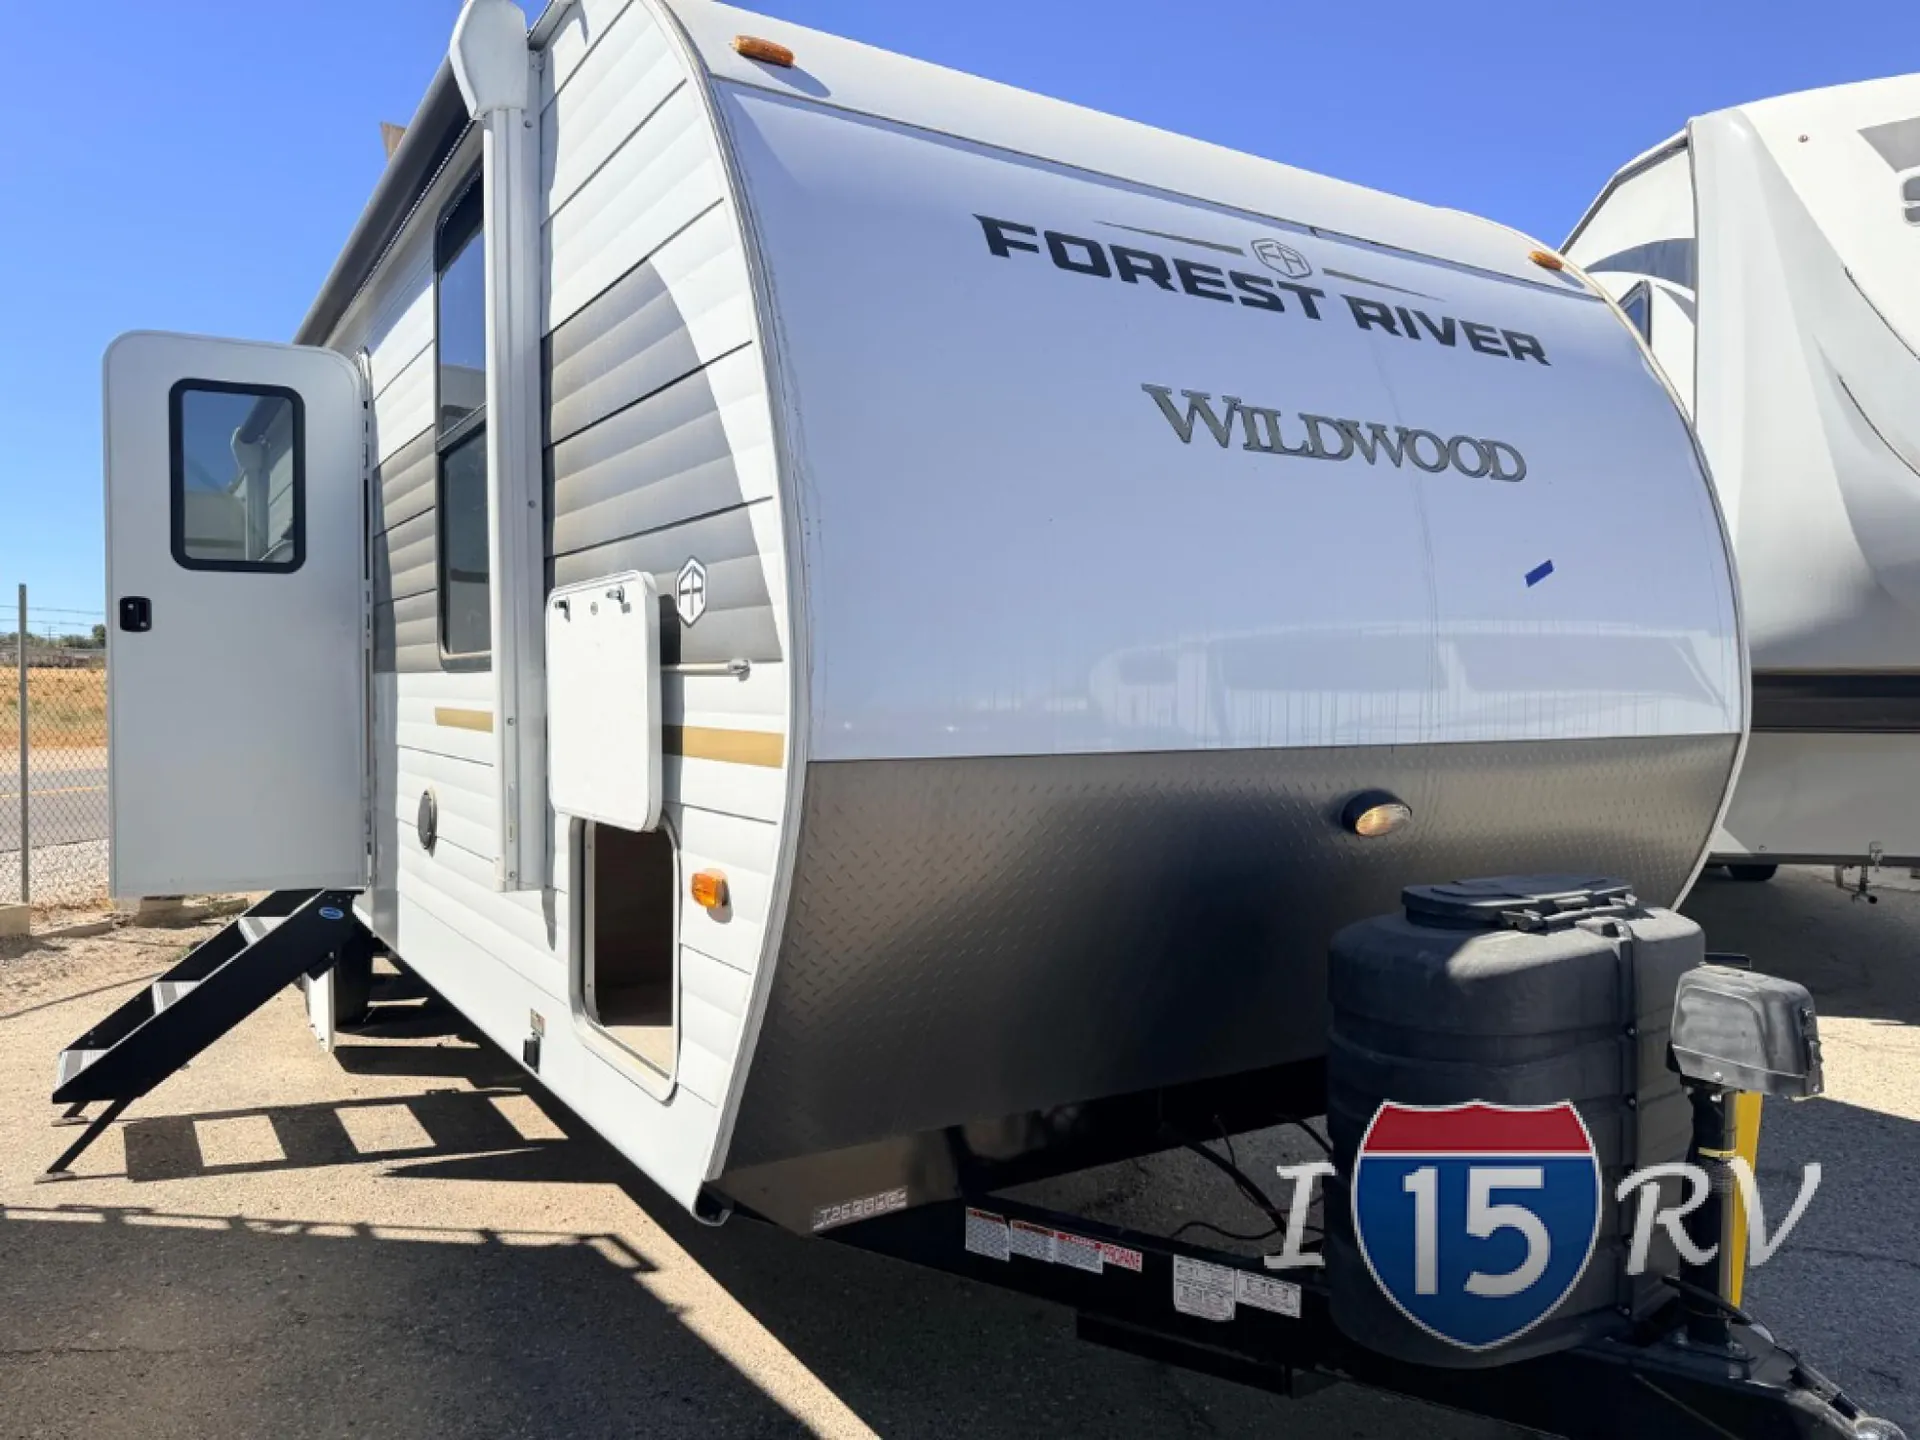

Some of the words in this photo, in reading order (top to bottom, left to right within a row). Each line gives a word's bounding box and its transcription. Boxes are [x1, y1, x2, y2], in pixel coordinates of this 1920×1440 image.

[973, 213, 1326, 320] FOREST
[1342, 293, 1552, 367] RIVER
[1140, 383, 1528, 483] WILDWOOD
